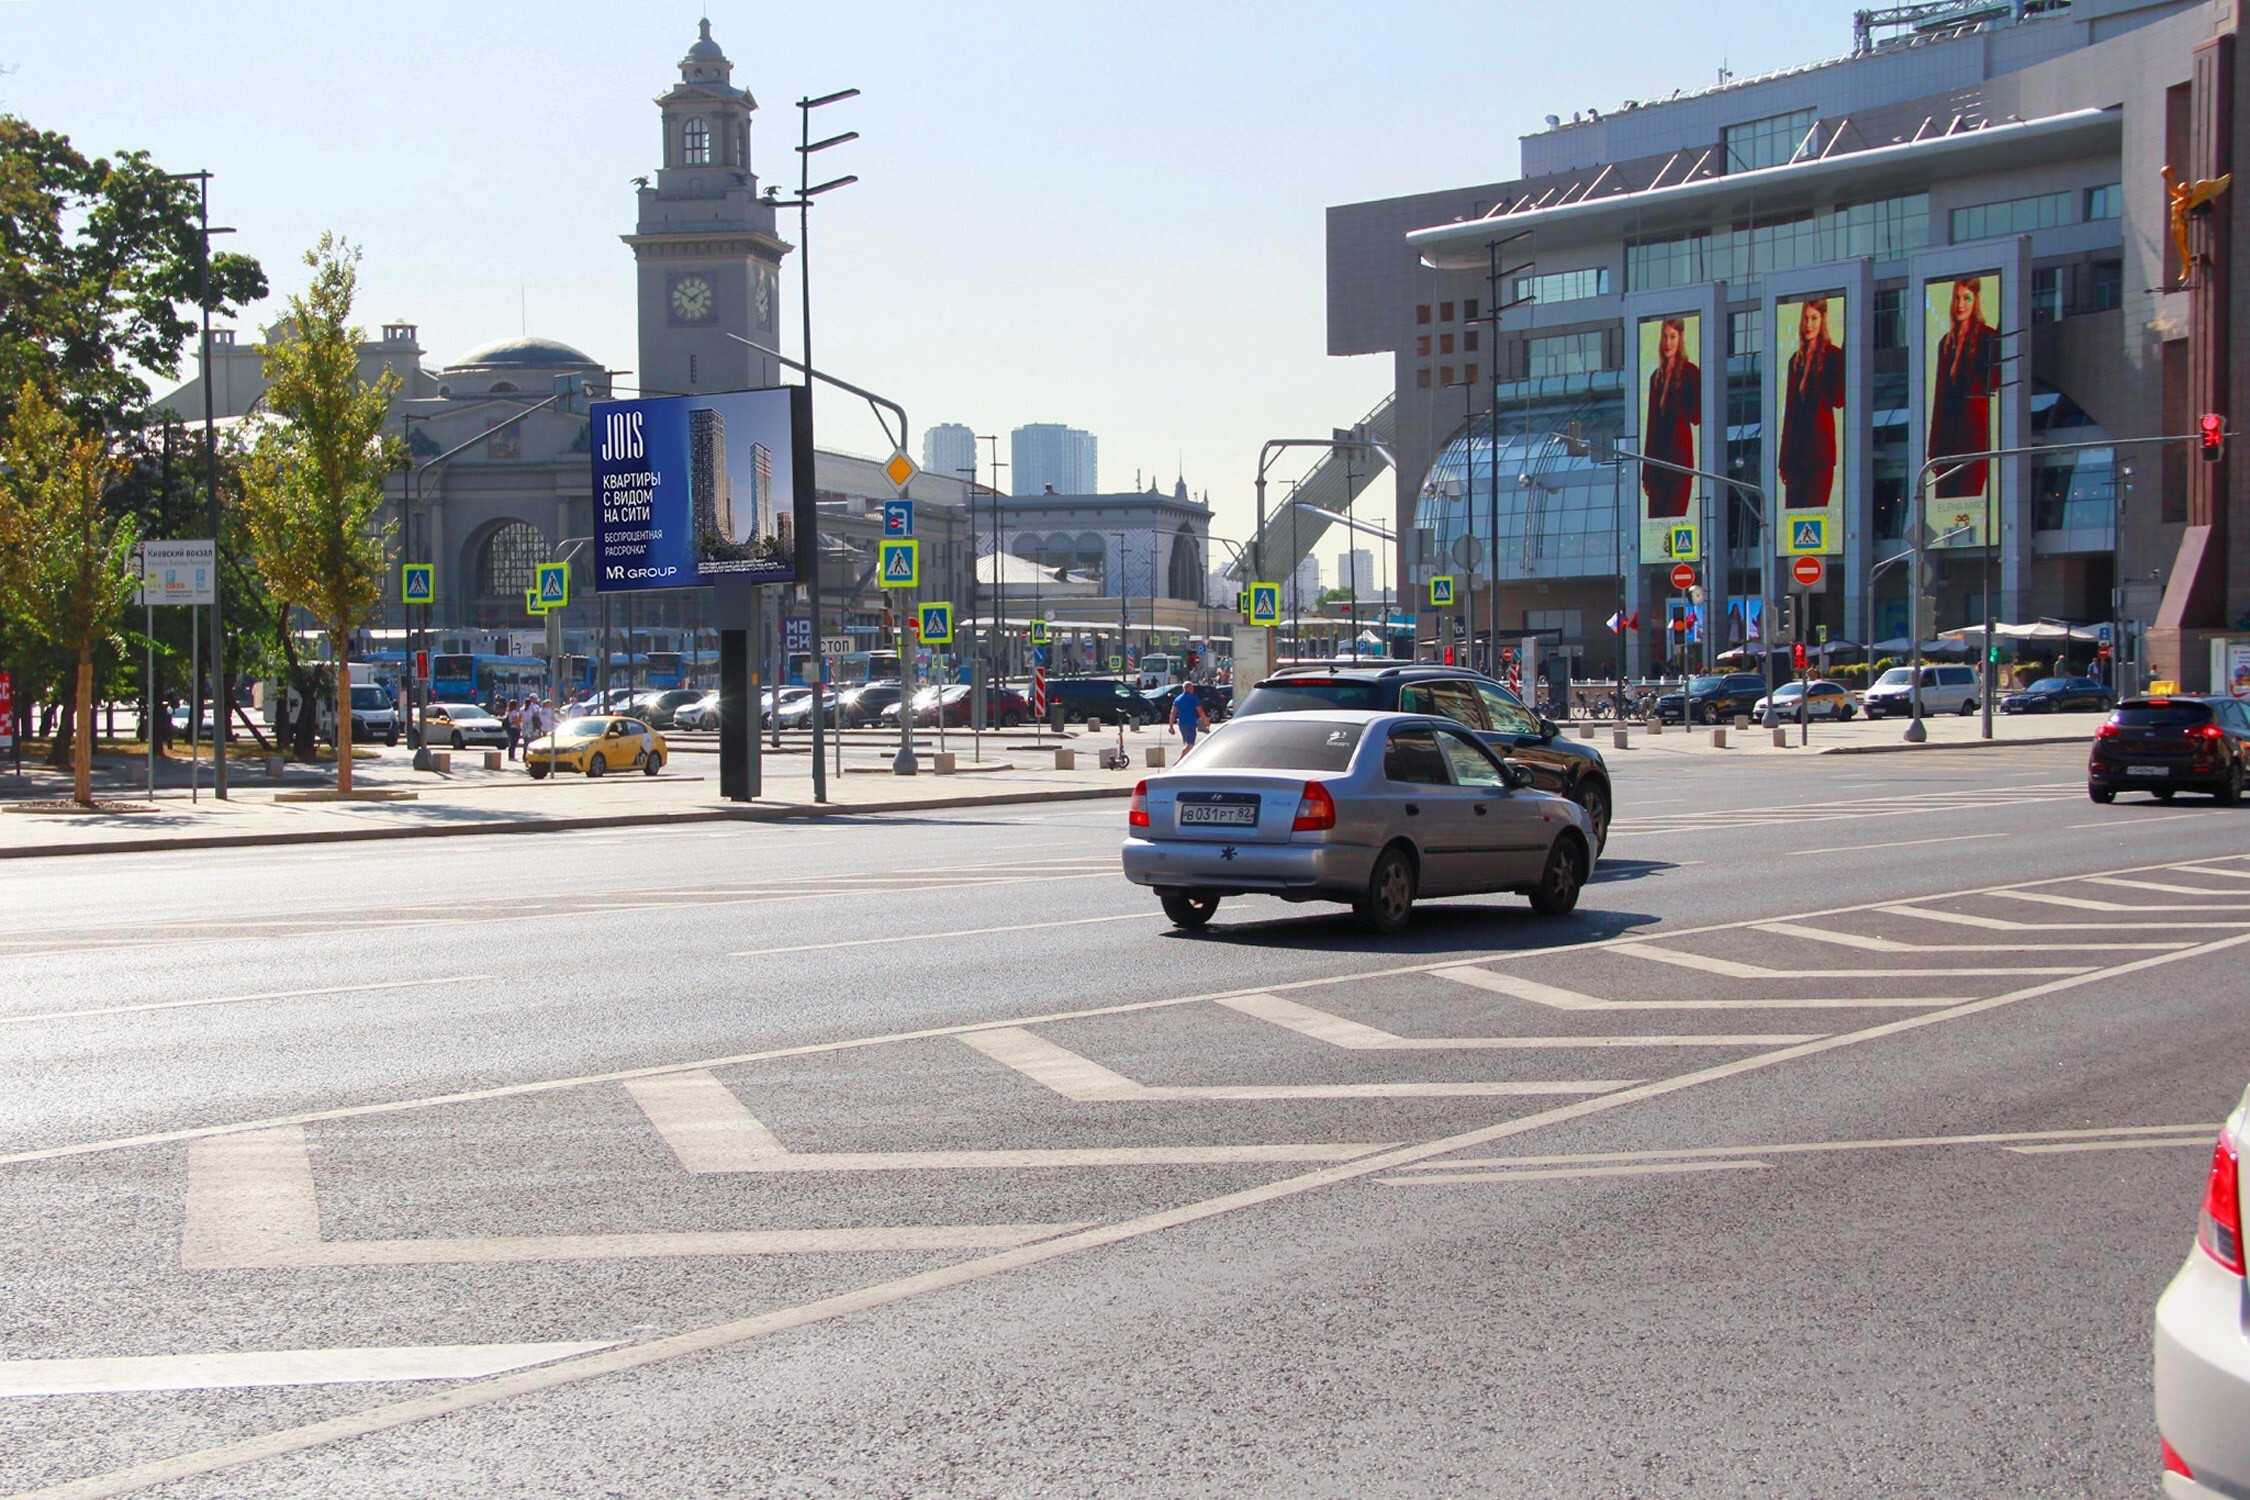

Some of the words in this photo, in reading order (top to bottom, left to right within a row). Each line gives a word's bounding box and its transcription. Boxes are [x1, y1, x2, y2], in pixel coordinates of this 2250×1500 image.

[602, 411, 643, 460] JOIS
[603, 471, 661, 489] КВАРТИРЫ
[603, 491, 611, 506] С
[613, 489, 653, 506] ВИДОМ
[604, 508, 619, 523] НА
[621, 506, 650, 522] СИТИ
[604, 529, 663, 543] БЕСПРОЦЕНТНАЯ
[147, 548, 184, 558] Киевский
[186, 549, 213, 558] вокзал
[606, 565, 625, 580] MR
[627, 566, 677, 579] GROUP
[820, 640, 850, 653] СТОП
[1237, 807, 1251, 818] 82
